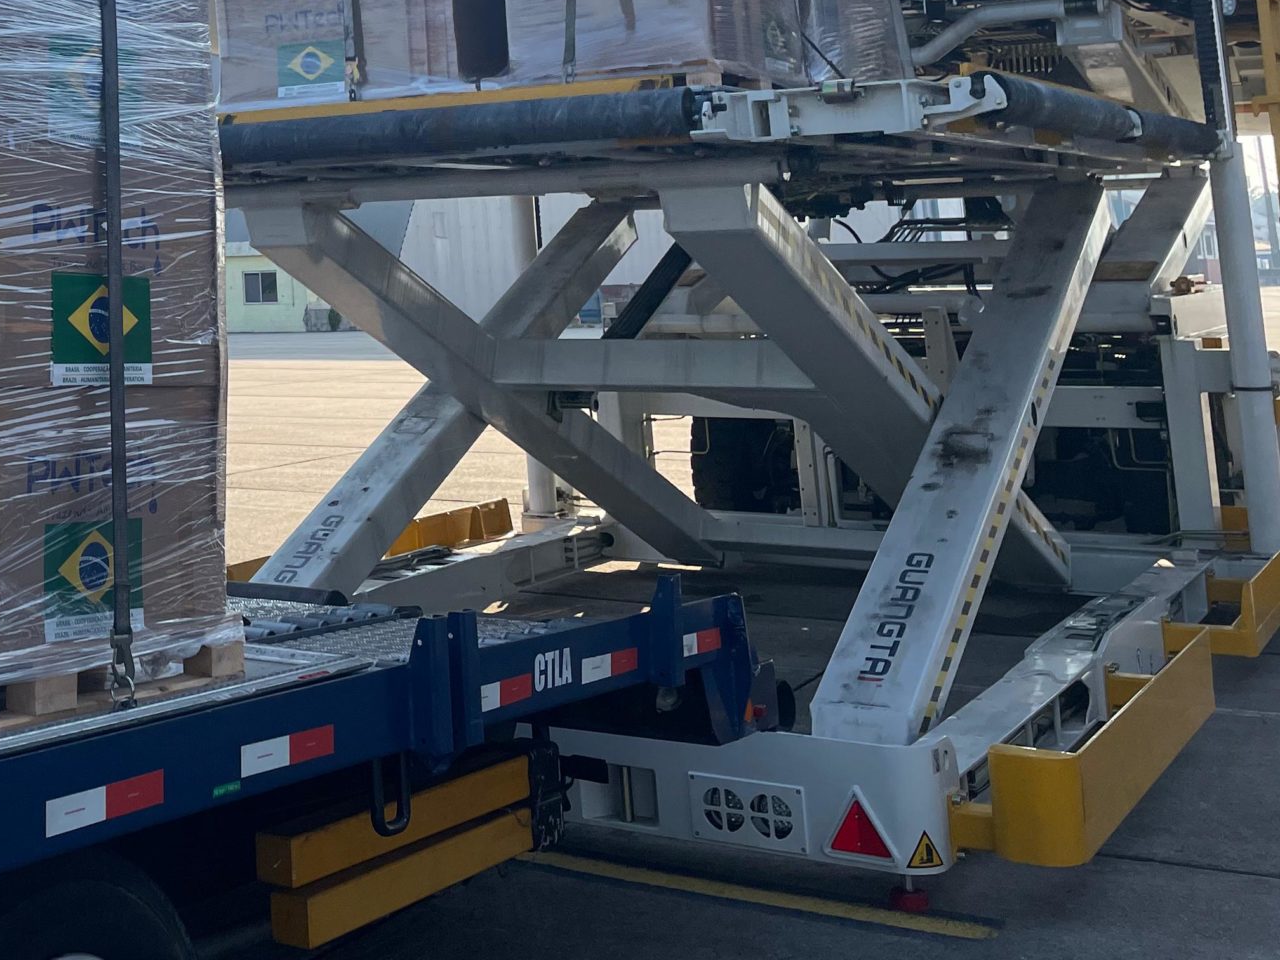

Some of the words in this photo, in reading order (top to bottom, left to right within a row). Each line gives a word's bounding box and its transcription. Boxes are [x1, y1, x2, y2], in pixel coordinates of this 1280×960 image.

[273, 515, 344, 584] GUANG
[857, 552, 935, 682] GUANGTAI
[534, 647, 572, 692] CTLA
